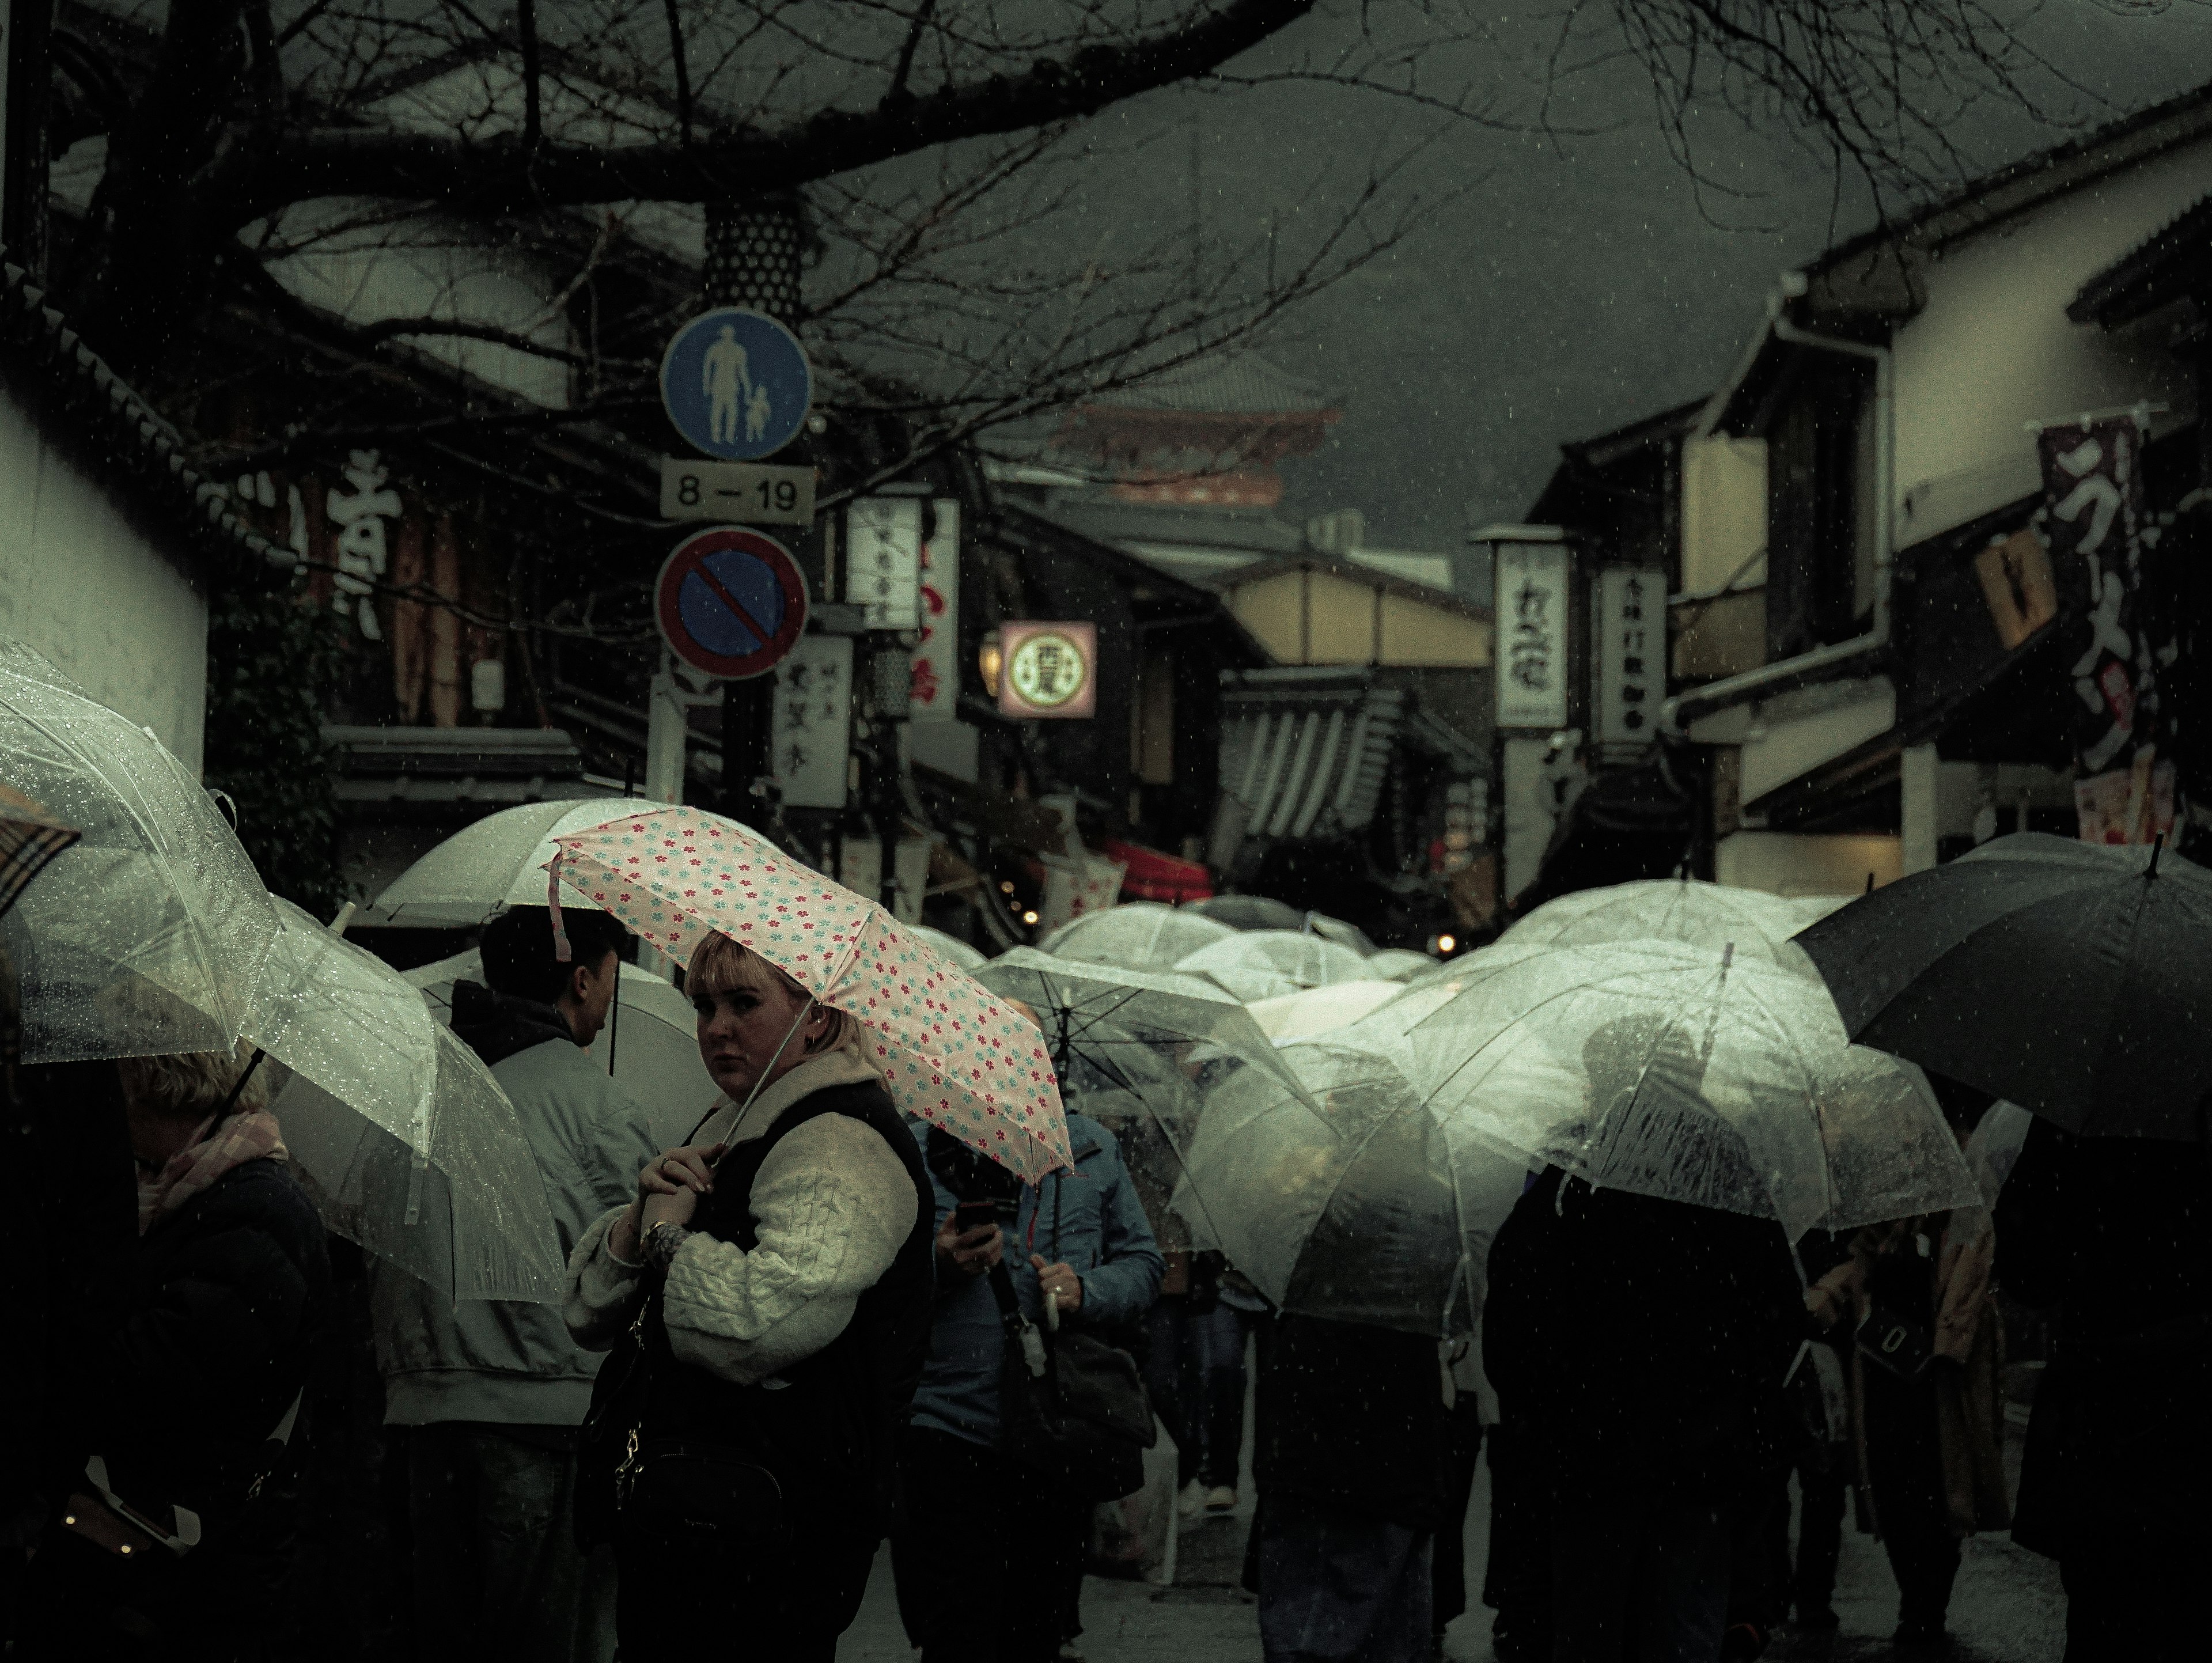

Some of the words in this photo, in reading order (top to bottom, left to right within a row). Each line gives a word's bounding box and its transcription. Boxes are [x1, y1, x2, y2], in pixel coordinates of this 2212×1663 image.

[679, 475, 699, 505] 8
[758, 480, 797, 511] 19
[2052, 437, 2133, 772] ラーメン
